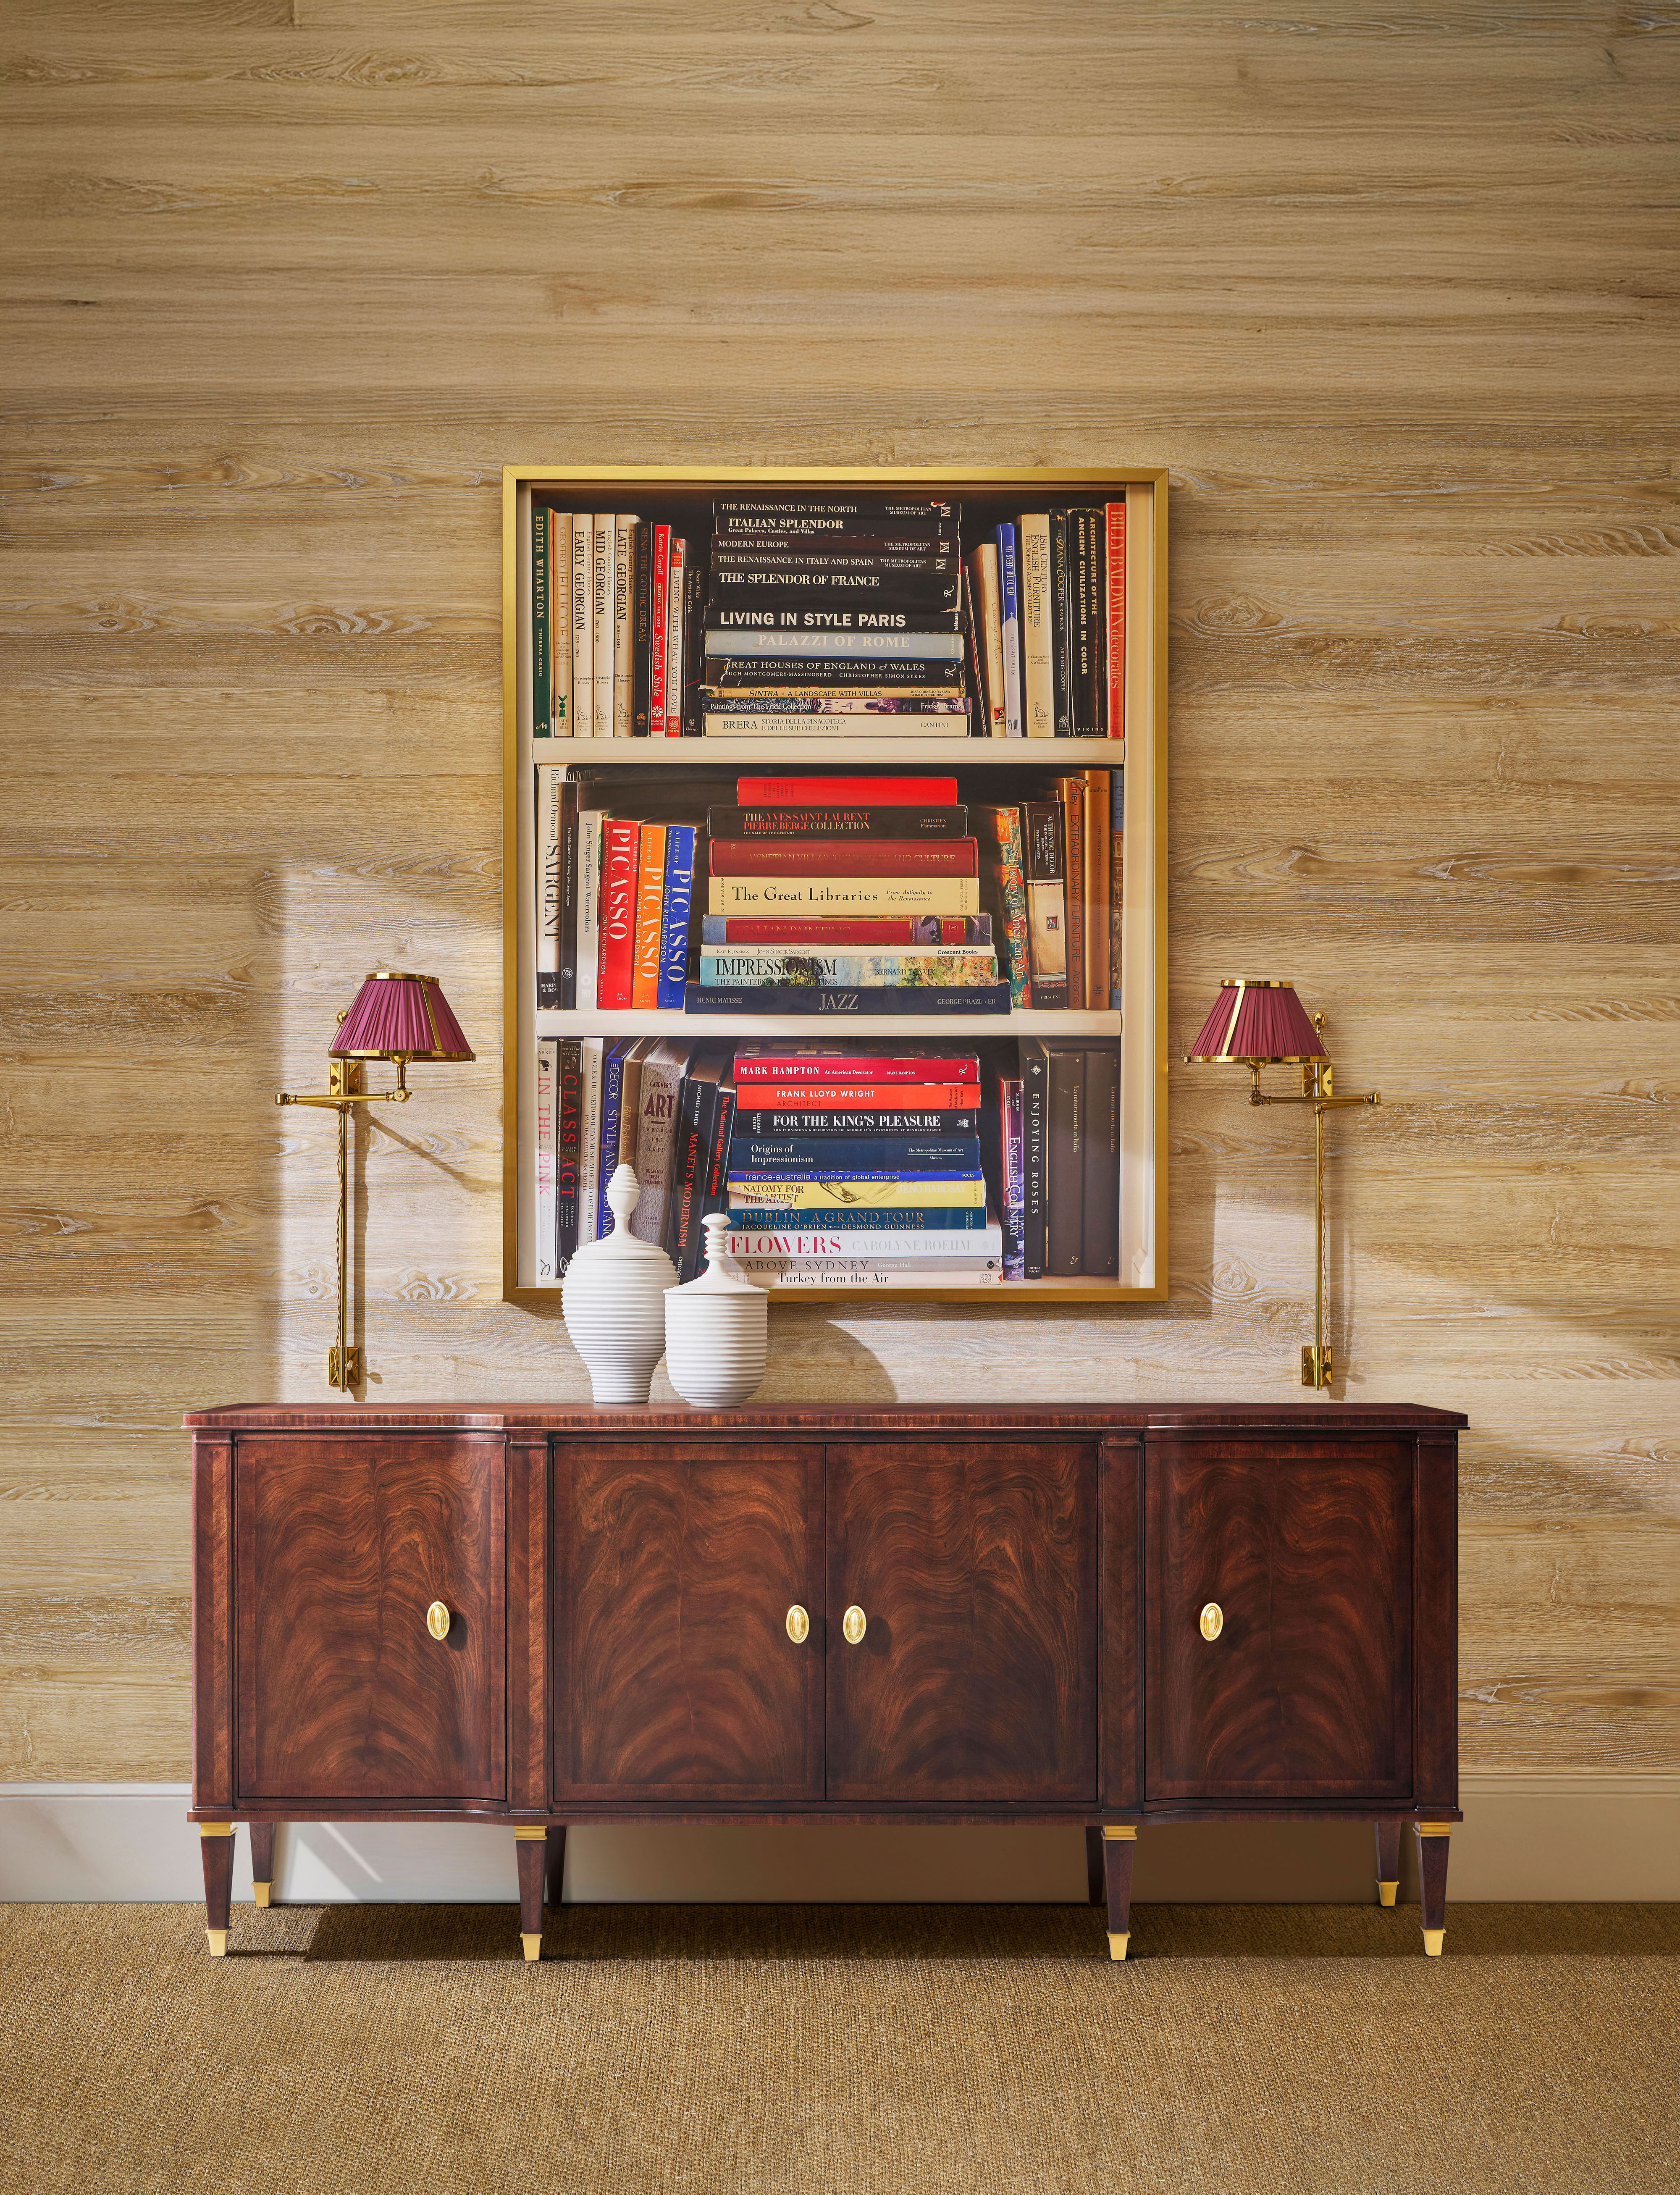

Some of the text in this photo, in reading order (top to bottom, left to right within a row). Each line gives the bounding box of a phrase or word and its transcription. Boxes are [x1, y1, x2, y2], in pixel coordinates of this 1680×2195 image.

[729, 518, 843, 528] ITALIAN SPLENDOR
[575, 531, 585, 630] EARLY GEORGIAN
[617, 529, 627, 620] LATE GEORGIAN
[719, 573, 879, 586] THE SPLENDOR OF FRANCE
[1092, 586, 1096, 596] OF
[721, 612, 906, 627] LIVING IN STYLE PARIS
[758, 635, 909, 647] PALAZZI OF ROME
[1081, 631, 1087, 640] IN
[652, 633, 663, 697] Swedish Style
[722, 721, 757, 729] BRERA
[550, 805, 559, 840] Ormond
[584, 841, 593, 862] Singer
[1071, 815, 1080, 901] EXTRAORDINARY
[584, 864, 592, 889] Sargent
[609, 828, 630, 939] PICASSO
[544, 845, 561, 941] SARGENT
[732, 887, 878, 901] The Great Libraries
[640, 867, 662, 978] PICASSO
[1007, 848, 1026, 979] A History of American Art
[667, 868, 690, 982] PICASSO
[1072, 905, 1080, 962] FURNITURE
[715, 959, 837, 975] IMPRESSIONISM
[819, 994, 858, 1011] JAZZ
[538, 1077, 550, 1095] IN
[538, 1104, 550, 1140] THE
[773, 1116, 940, 1126] FOR THE KING'S PLEASURE
[1031, 1093, 1040, 1162] ENJOYING
[562, 1075, 577, 1198] CLASS ACT
[751, 1144, 794, 1155] Origins of
[751, 1155, 813, 1165] Impressionism
[539, 1153, 550, 1196] PINK
[678, 1132, 698, 1247] MANET'S MODERNISM
[743, 1212, 924, 1222] DUBLIN A GRAND TOUR
[730, 1236, 841, 1254] FLOWERS
[746, 1261, 869, 1270] ABOVE SYDNEY
[778, 1271, 889, 1285] Turkey from the Air
